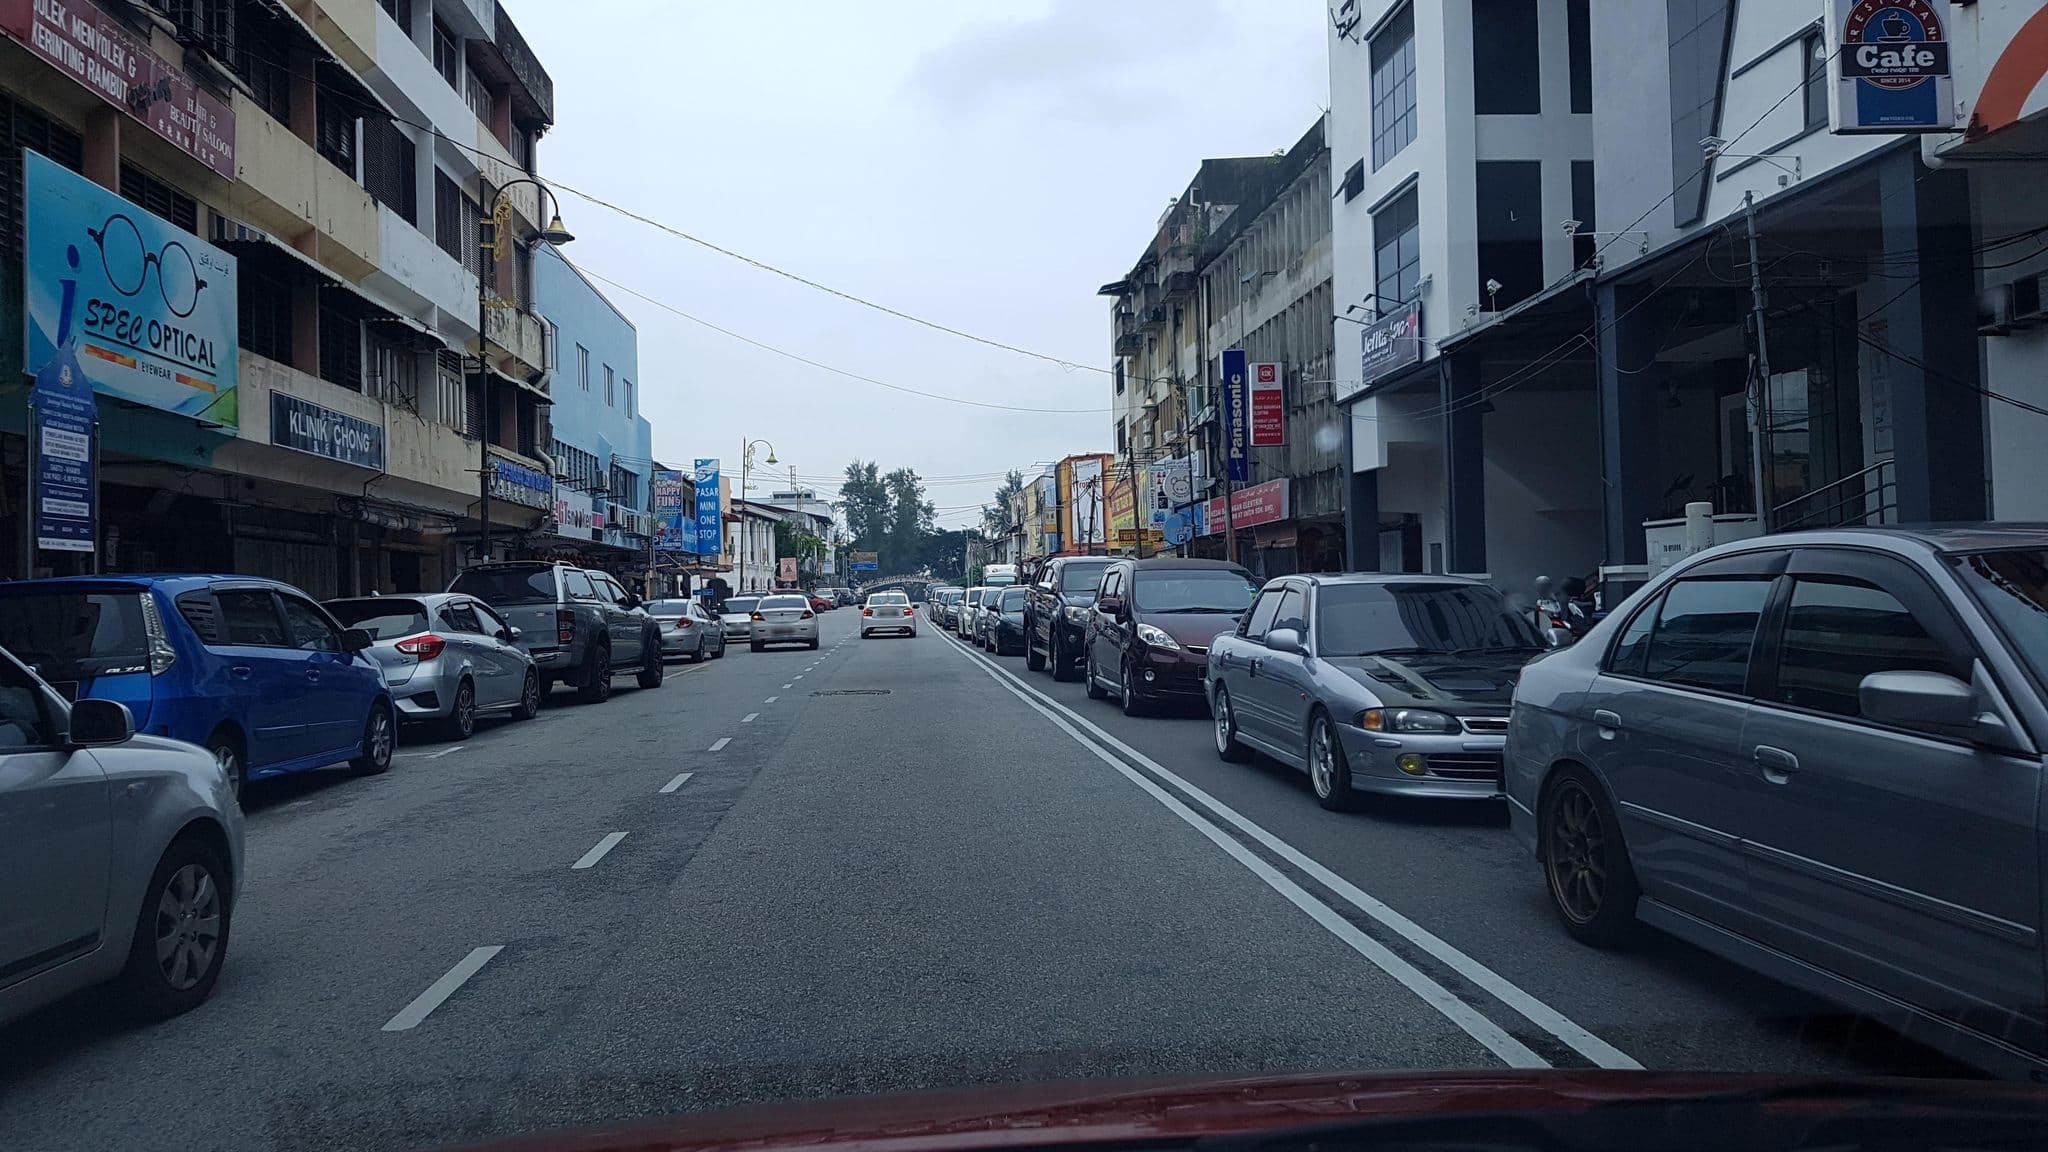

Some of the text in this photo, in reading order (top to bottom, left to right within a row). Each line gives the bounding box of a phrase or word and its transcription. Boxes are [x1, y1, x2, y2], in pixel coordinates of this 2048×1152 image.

[72, 14, 125, 75] MENYOLEK
[1856, 45, 1934, 68] Cafe
[31, 21, 84, 75] KERINTING
[87, 57, 129, 104] RAMBUT
[169, 104, 201, 137] BEAUTY
[202, 129, 233, 160] SALOON
[84, 299, 216, 369] SPEC OPTICAL
[141, 361, 171, 381] EYEWEAR
[290, 410, 328, 442] KLINIK
[334, 425, 370, 453] CHONG
[1230, 373, 1243, 459] Panasonic
[696, 488, 718, 496] PASAR
[700, 502, 716, 511] MINI
[700, 516, 716, 525] ONE
[700, 530, 717, 539] STOP
